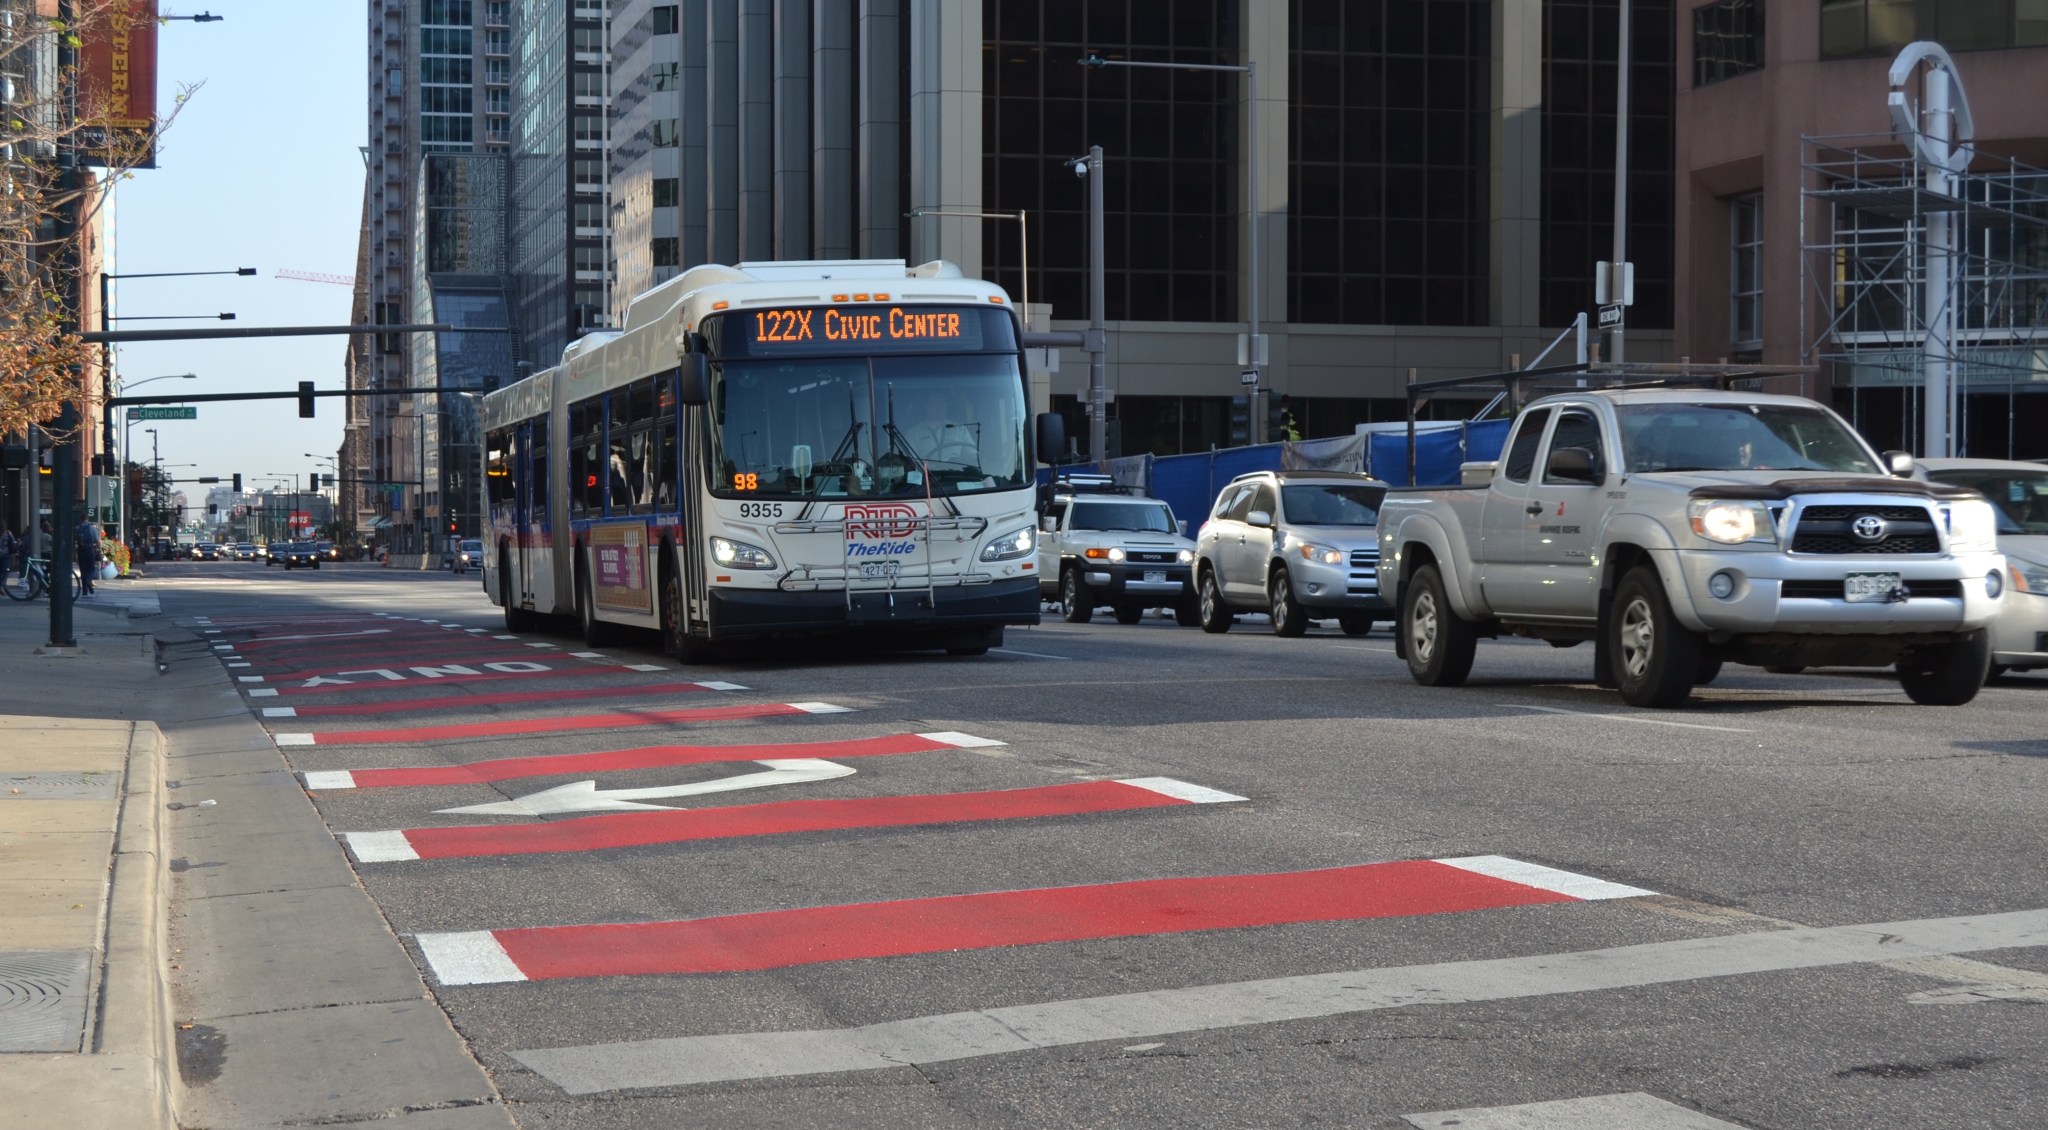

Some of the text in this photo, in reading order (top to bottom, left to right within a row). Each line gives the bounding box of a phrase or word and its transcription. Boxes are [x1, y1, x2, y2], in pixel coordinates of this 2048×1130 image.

[756, 310, 813, 342] 122X
[139, 409, 185, 418] Cleveland
[734, 473, 758, 490] 98
[740, 503, 782, 518] 9355
[844, 503, 918, 539] RTD
[847, 541, 916, 556] TheRide
